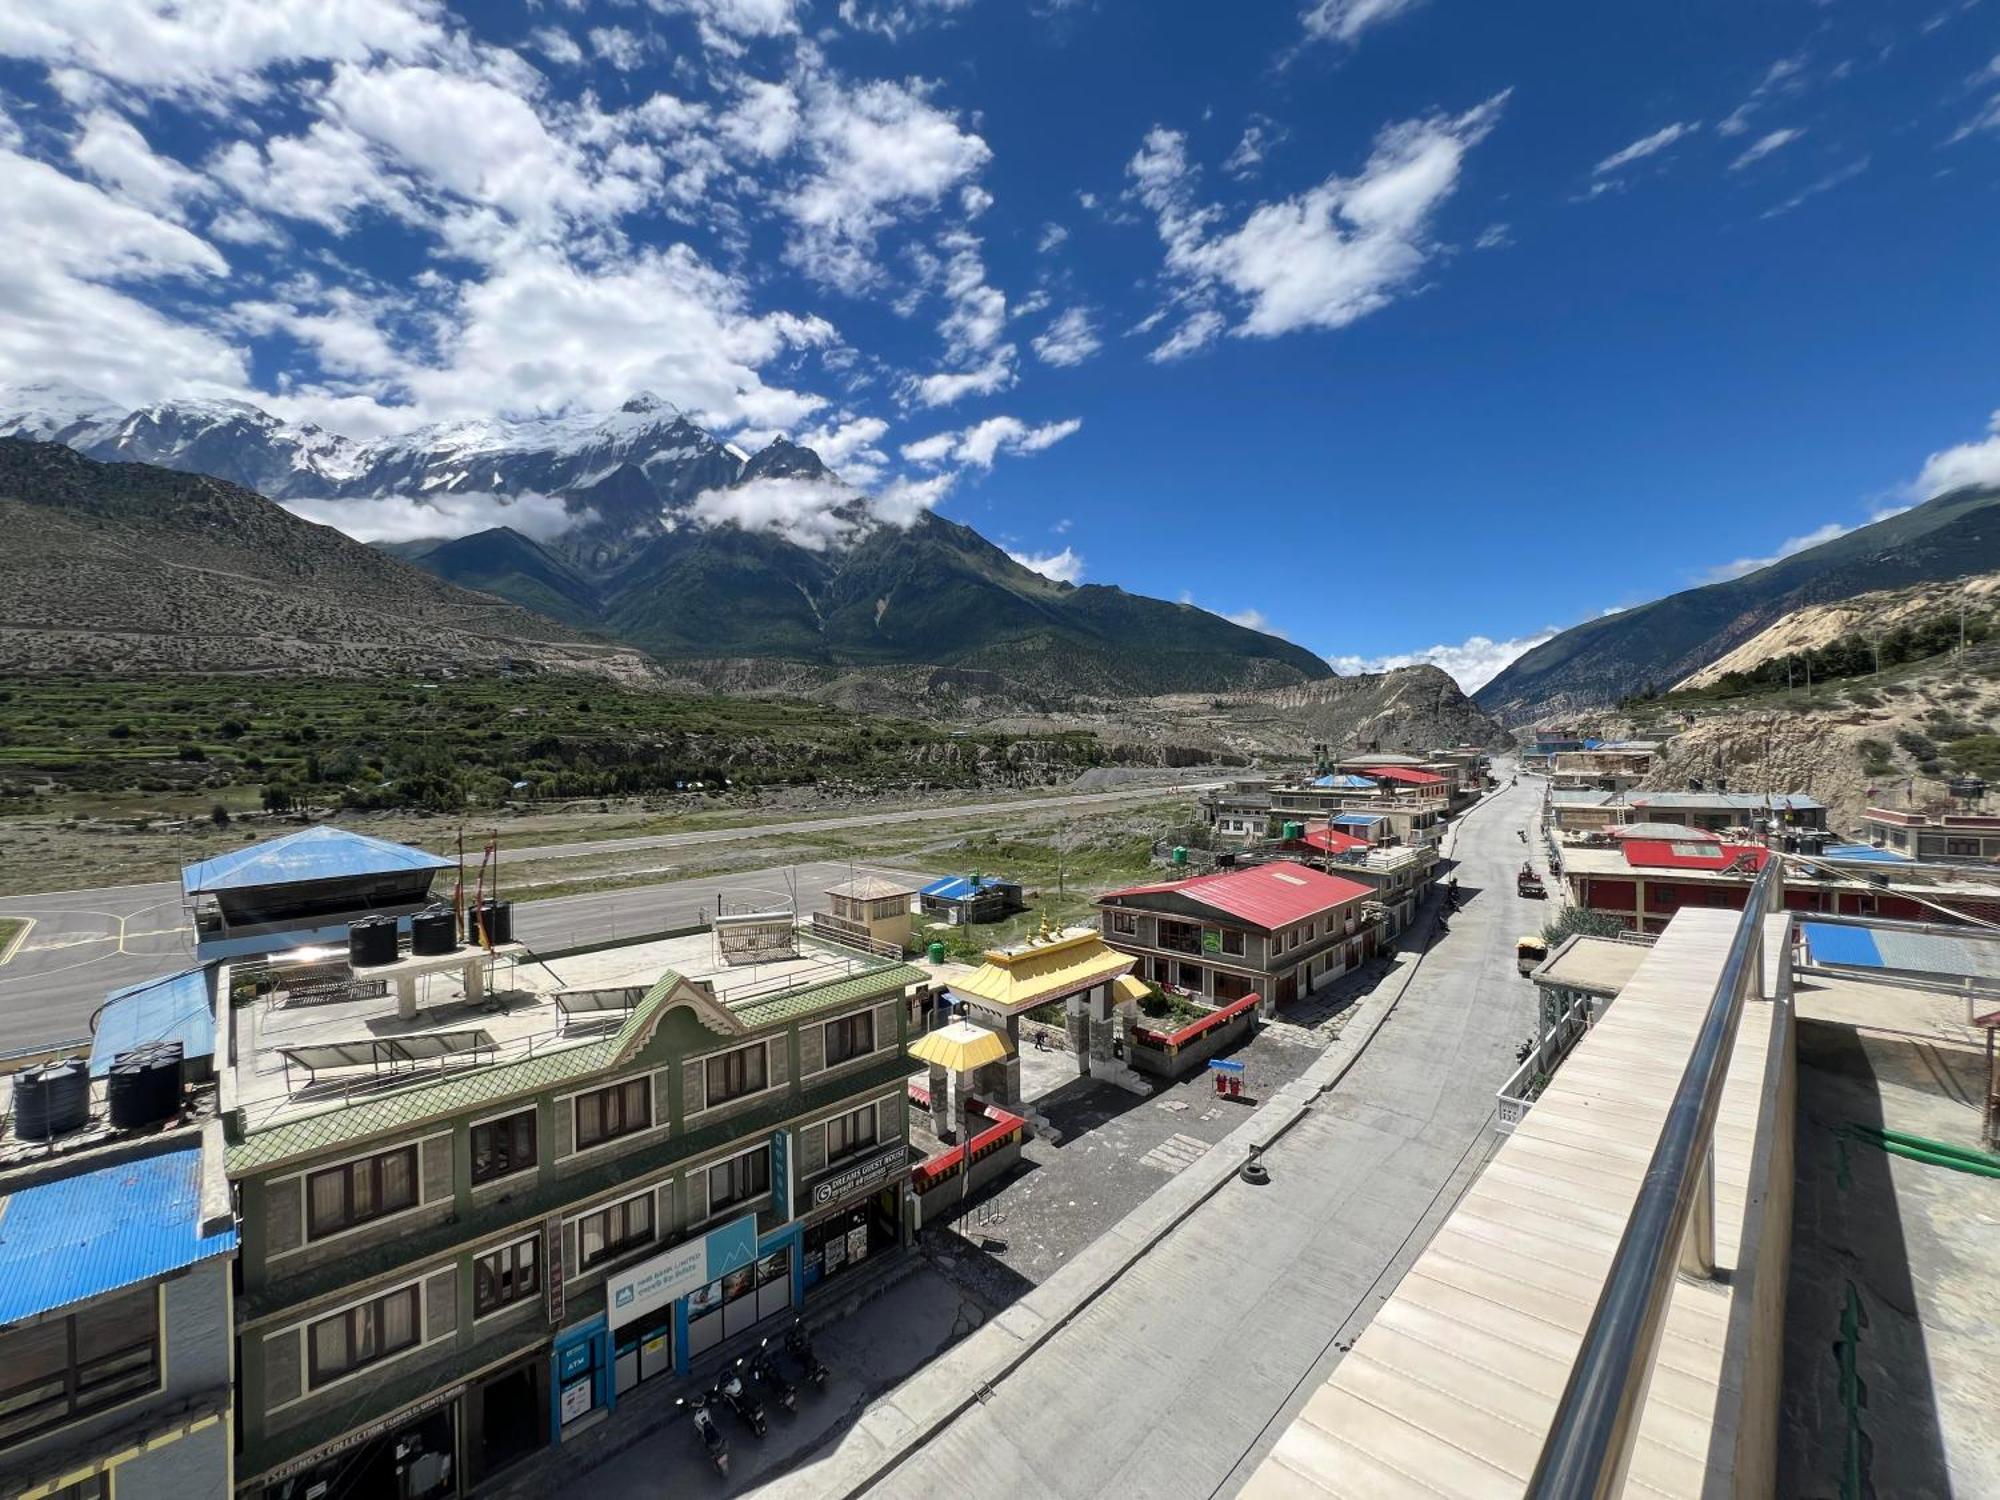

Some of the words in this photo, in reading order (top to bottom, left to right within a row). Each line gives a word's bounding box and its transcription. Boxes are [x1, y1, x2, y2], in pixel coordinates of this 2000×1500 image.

[832, 1169, 861, 1189] DREAMS
[862, 1159, 882, 1176] GUEST
[883, 1148, 905, 1165] HOUSE
[567, 1357, 585, 1371] ATM
[326, 1422, 385, 1454] COLLECTION
